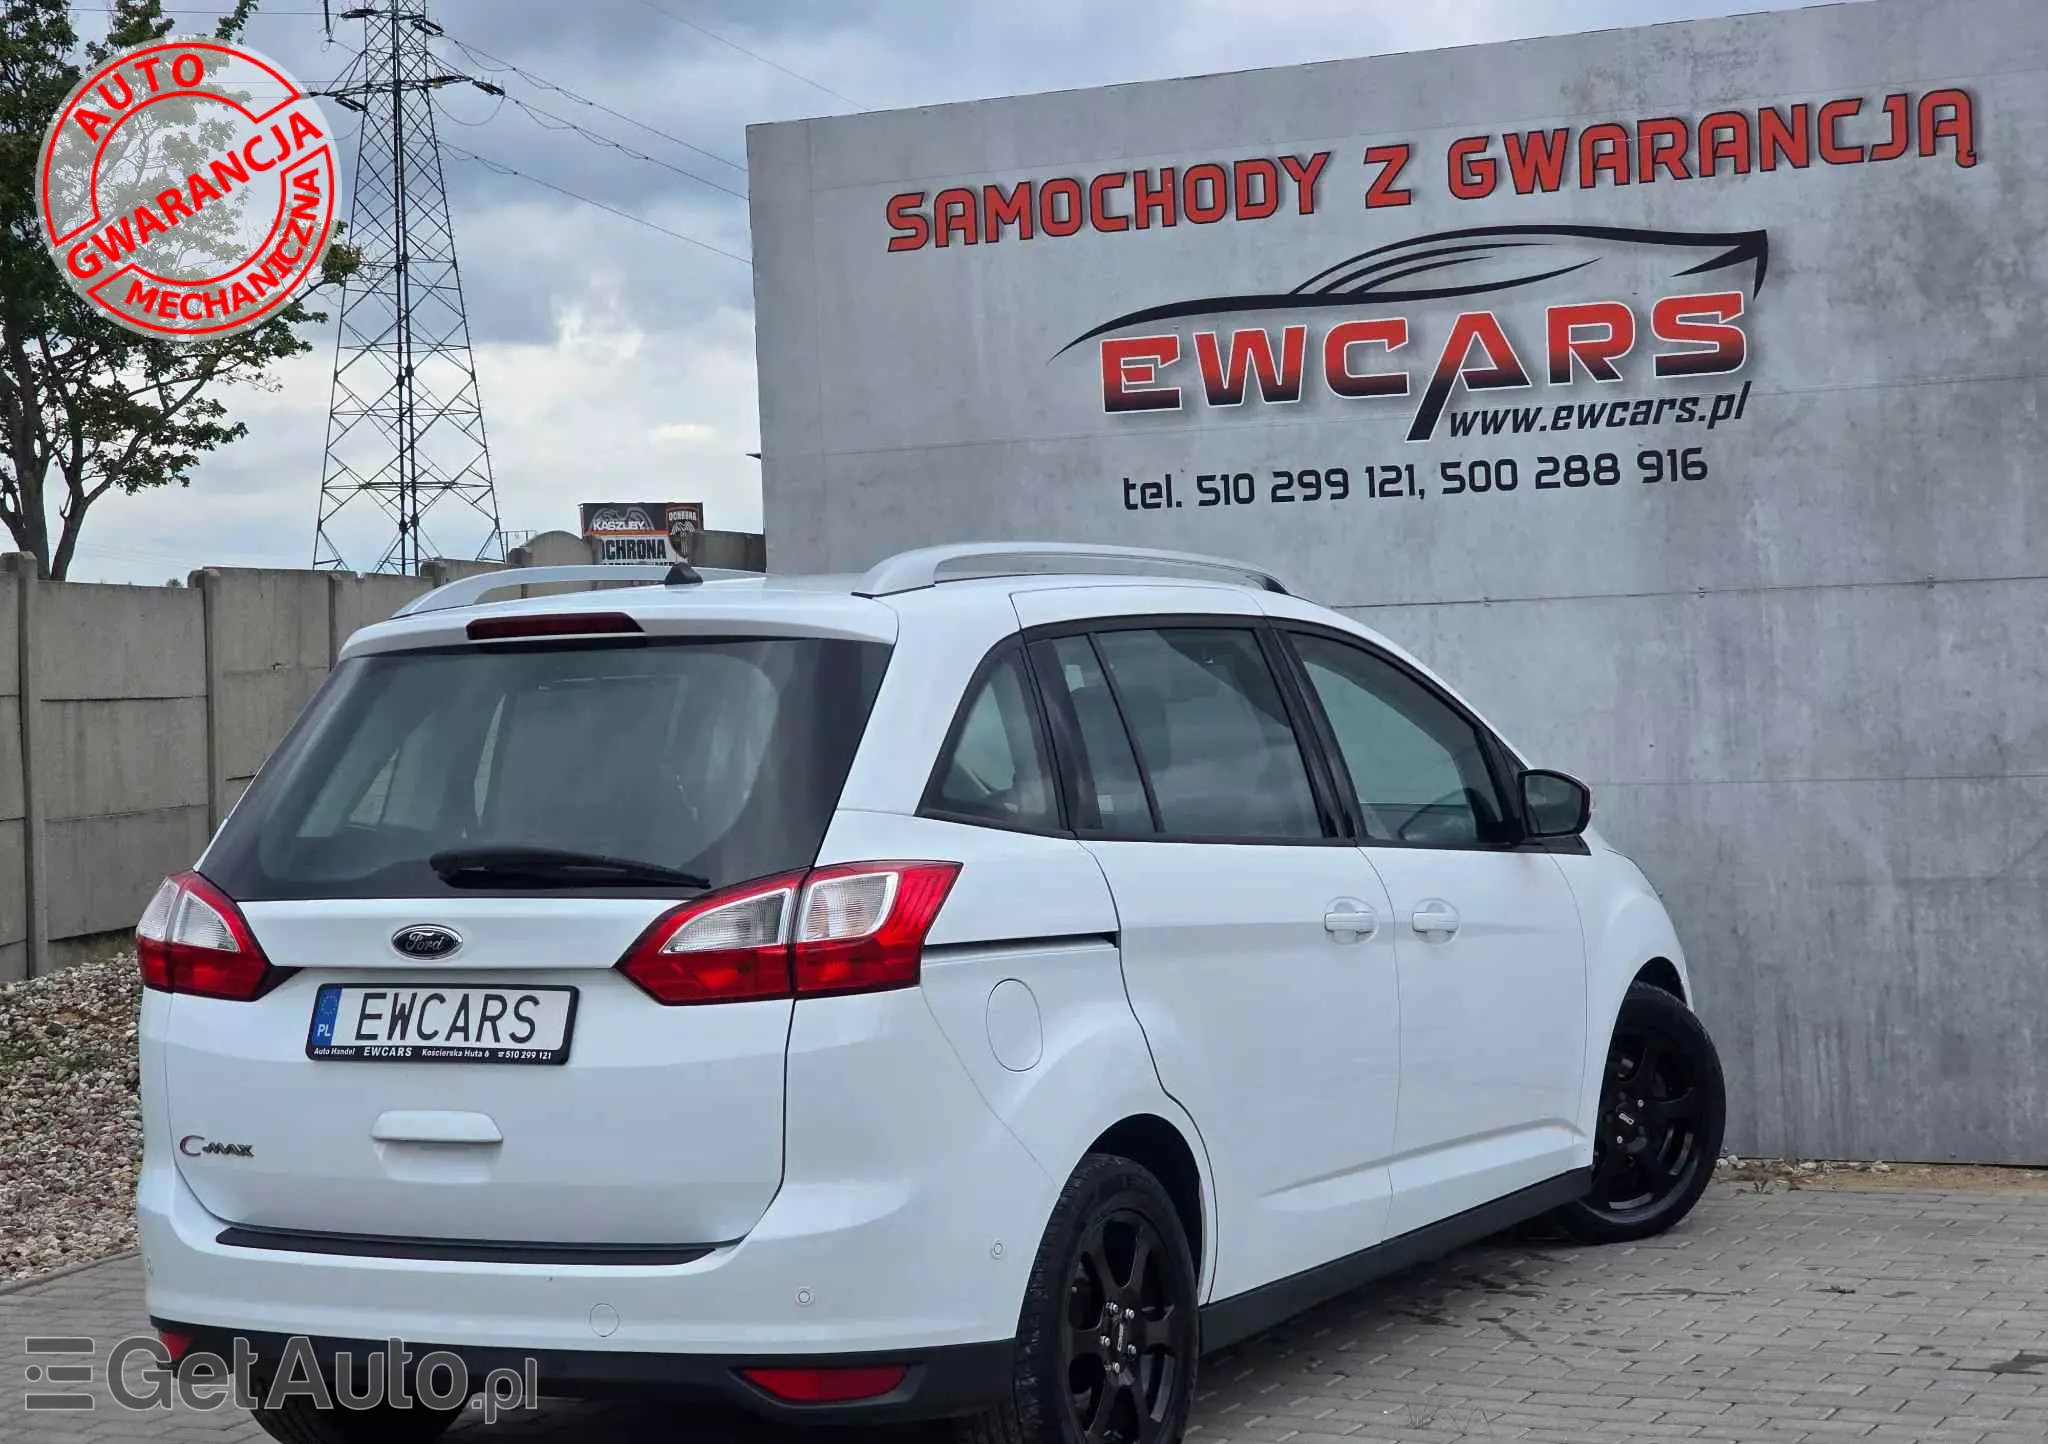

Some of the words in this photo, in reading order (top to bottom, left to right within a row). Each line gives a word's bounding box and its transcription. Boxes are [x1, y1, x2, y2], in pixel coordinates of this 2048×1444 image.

[886, 152, 1331, 253] SAMOCHODY
[1363, 143, 1412, 209] Z
[1447, 88, 1978, 202] GWARANCJĄ
[1101, 290, 1748, 442] EWCARS
[1449, 381, 1753, 438] www.ewcars.pl
[1123, 474, 1183, 511] tel.
[1197, 473, 1255, 506] 510
[1271, 467, 1350, 502] 299
[1365, 463, 1426, 500] 121,
[1440, 459, 1518, 495] 500
[1535, 454, 1621, 491] 288
[1636, 447, 1709, 484] 916
[405, 931, 445, 951] Ford
[355, 992, 540, 1043] EWCARS
[317, 1024, 331, 1037] PL
[314, 1047, 330, 1055] Auto
[331, 1047, 356, 1056] Handel
[363, 1046, 412, 1057] EWCARS
[463, 1048, 482, 1057] Huta
[505, 1050, 519, 1059] 510
[520, 1051, 536, 1060] 299
[538, 1052, 552, 1060] 121
